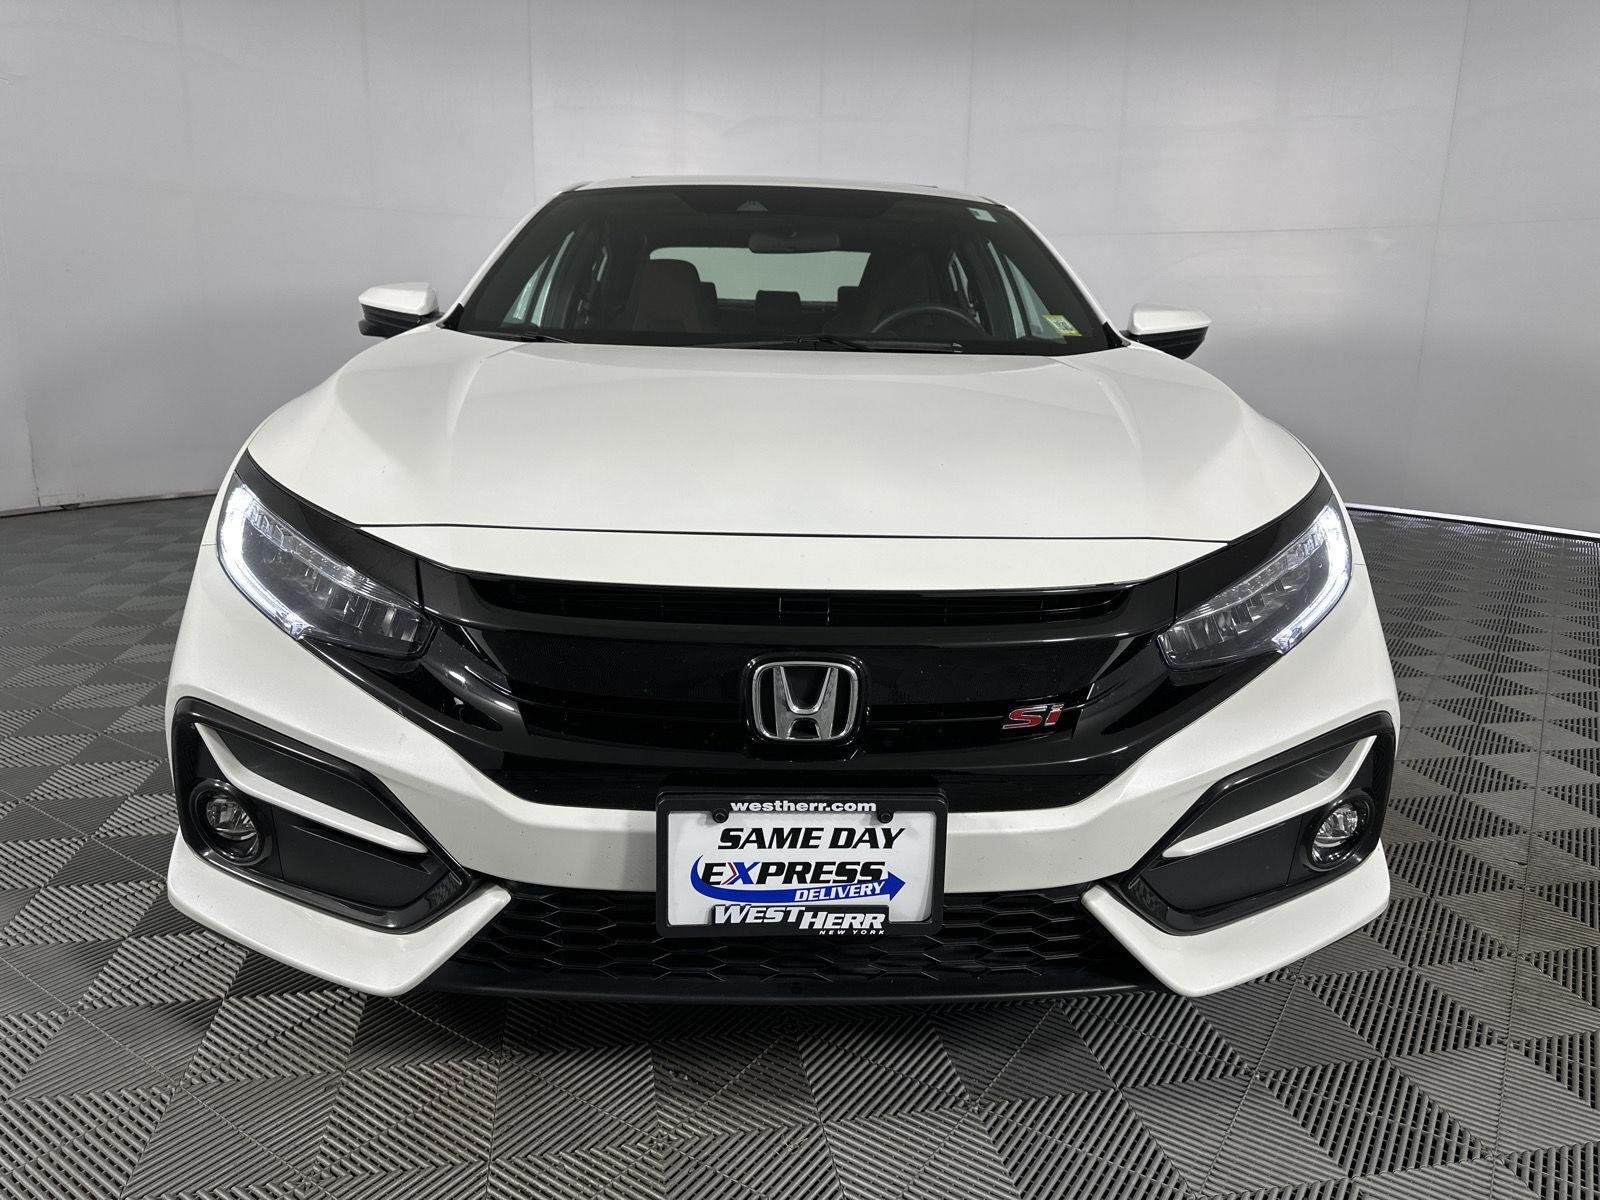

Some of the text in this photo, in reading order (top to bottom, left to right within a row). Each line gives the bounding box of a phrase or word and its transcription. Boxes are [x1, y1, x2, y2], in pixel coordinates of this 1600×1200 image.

[1002, 703, 1064, 729] Si
[730, 800, 877, 812] westherr.com
[718, 828, 905, 850] SAME DAY
[701, 861, 886, 885] EXPRESS
[794, 881, 885, 901] DELIVERY
